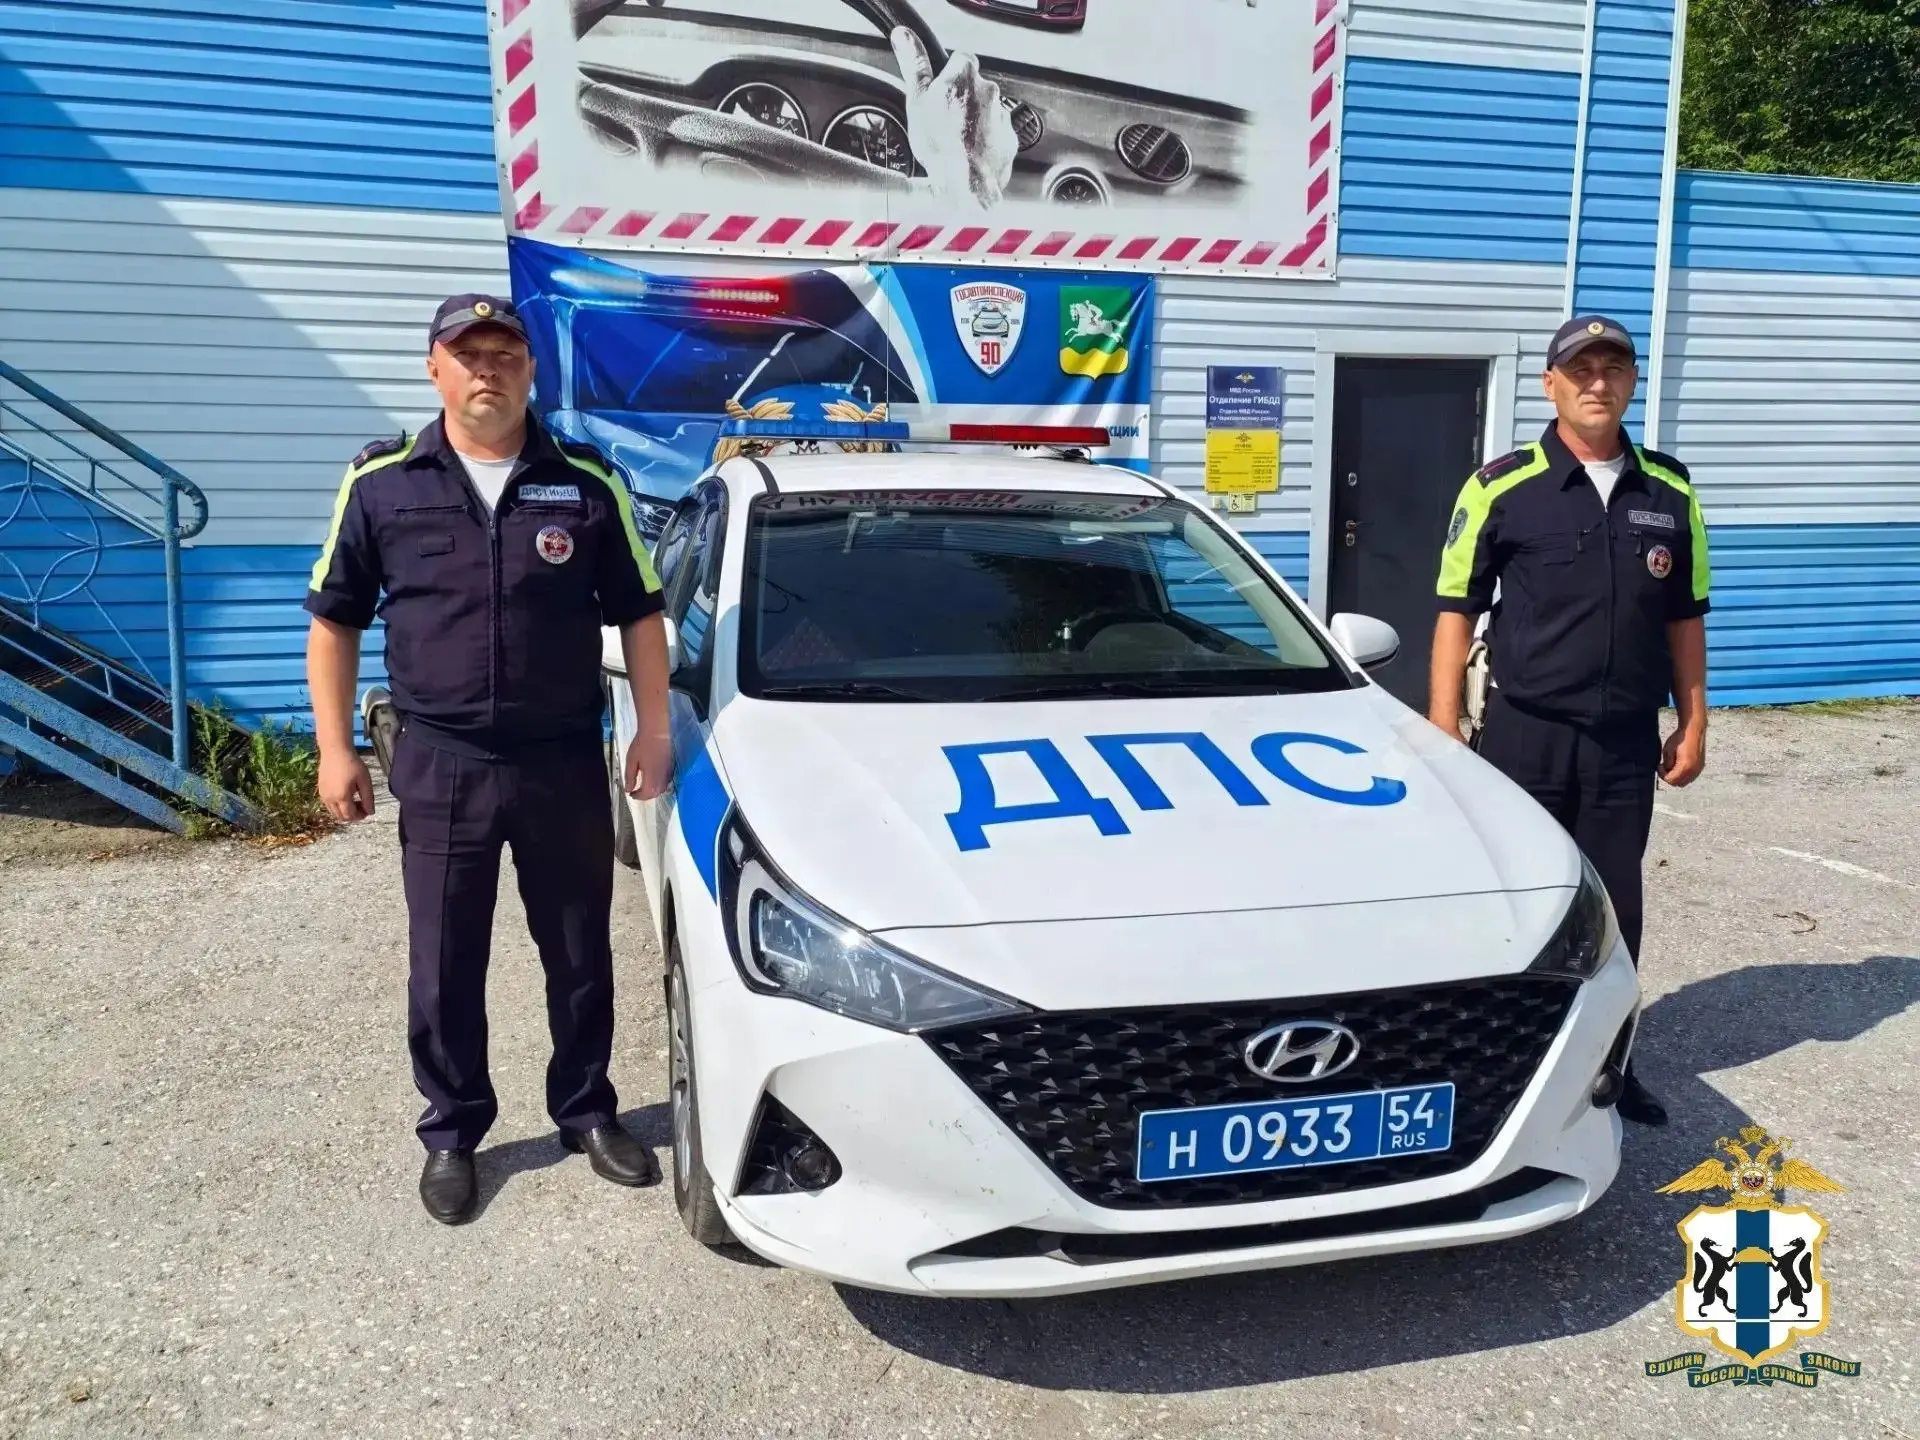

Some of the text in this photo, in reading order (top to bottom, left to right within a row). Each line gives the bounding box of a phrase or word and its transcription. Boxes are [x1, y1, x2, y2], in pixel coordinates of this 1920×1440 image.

[980, 341, 1001, 365] 90
[1209, 395, 1281, 405] Отделение ГИБДД
[940, 731, 1408, 852] ДПС
[1222, 1104, 1353, 1164] 0933
[1387, 1092, 1434, 1132] 54
[1391, 1131, 1426, 1149] RUS
